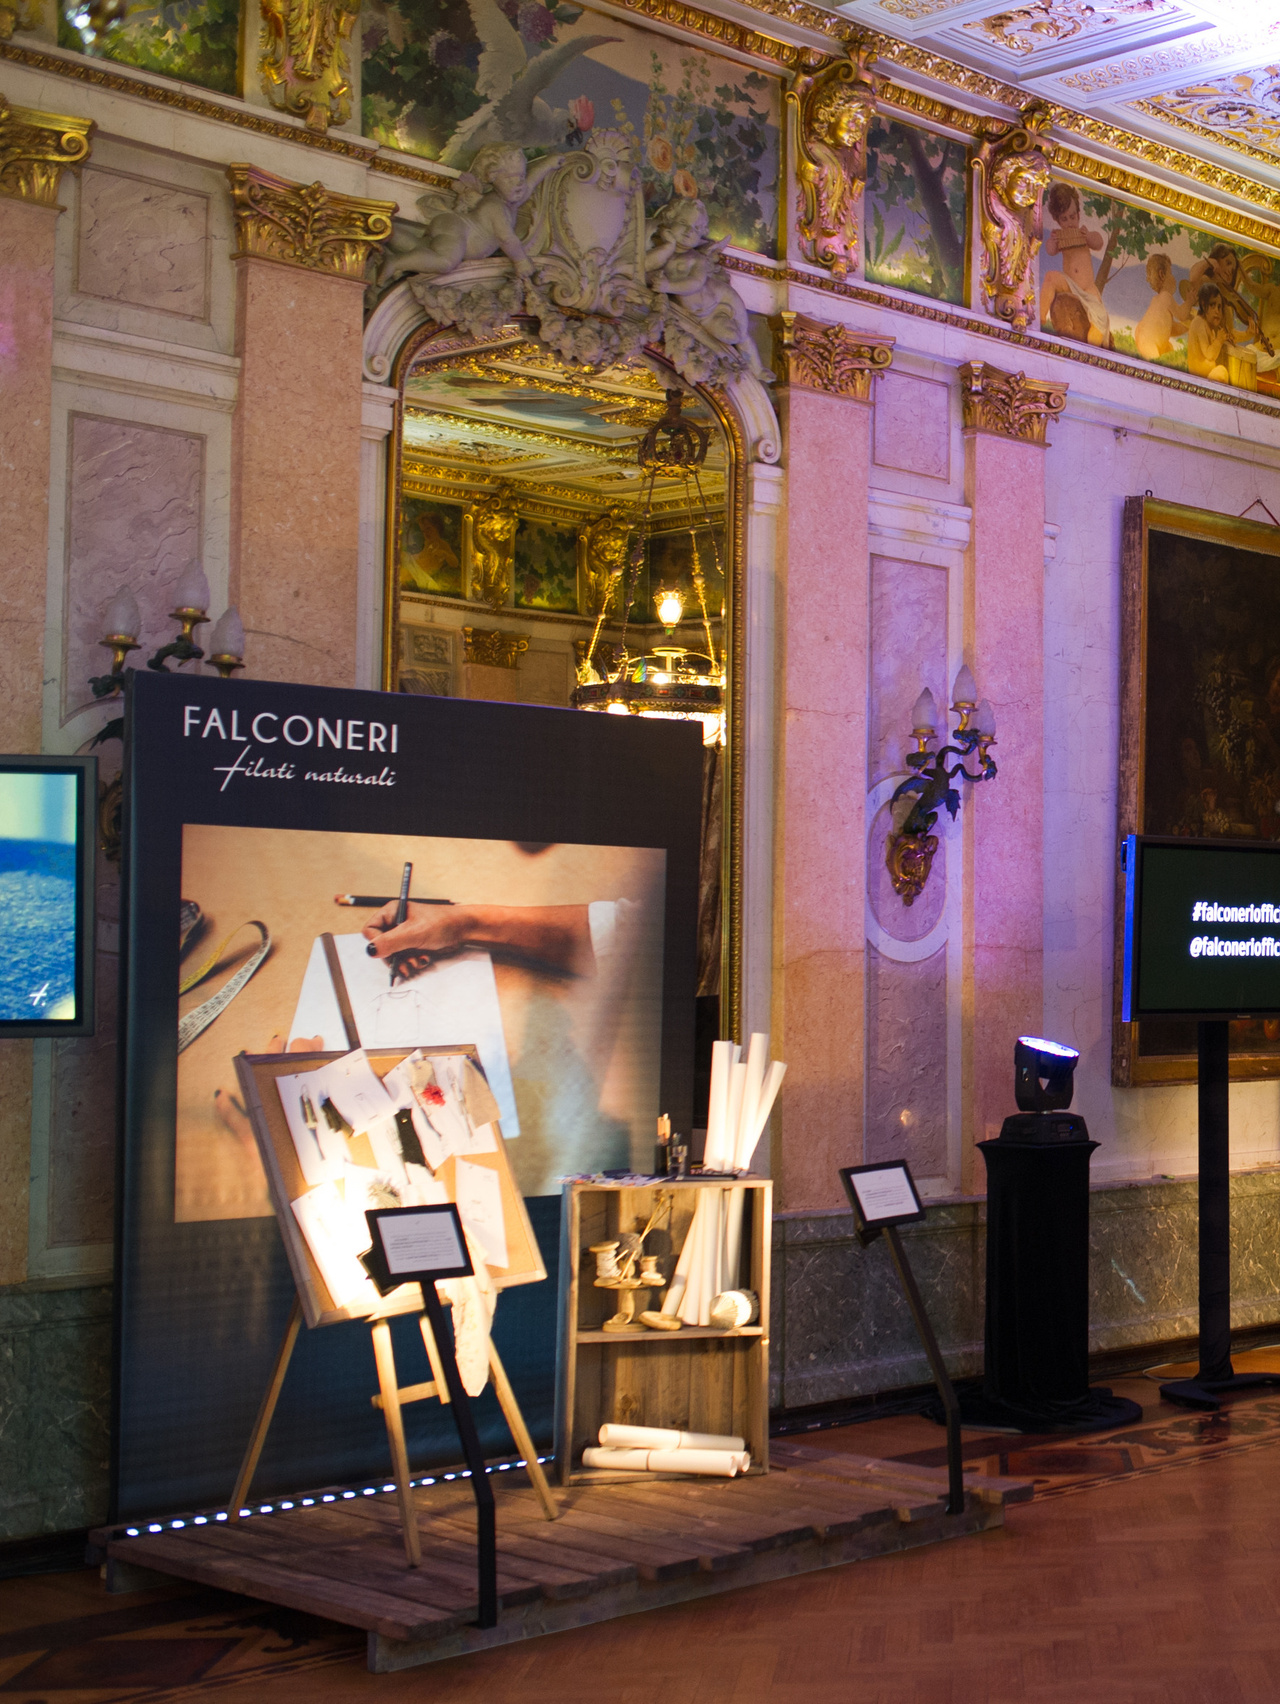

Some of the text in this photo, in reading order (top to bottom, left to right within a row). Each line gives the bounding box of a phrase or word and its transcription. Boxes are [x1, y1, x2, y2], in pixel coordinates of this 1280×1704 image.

[184, 705, 398, 753] FALCONERI
[213, 744, 396, 792] filati naturali
